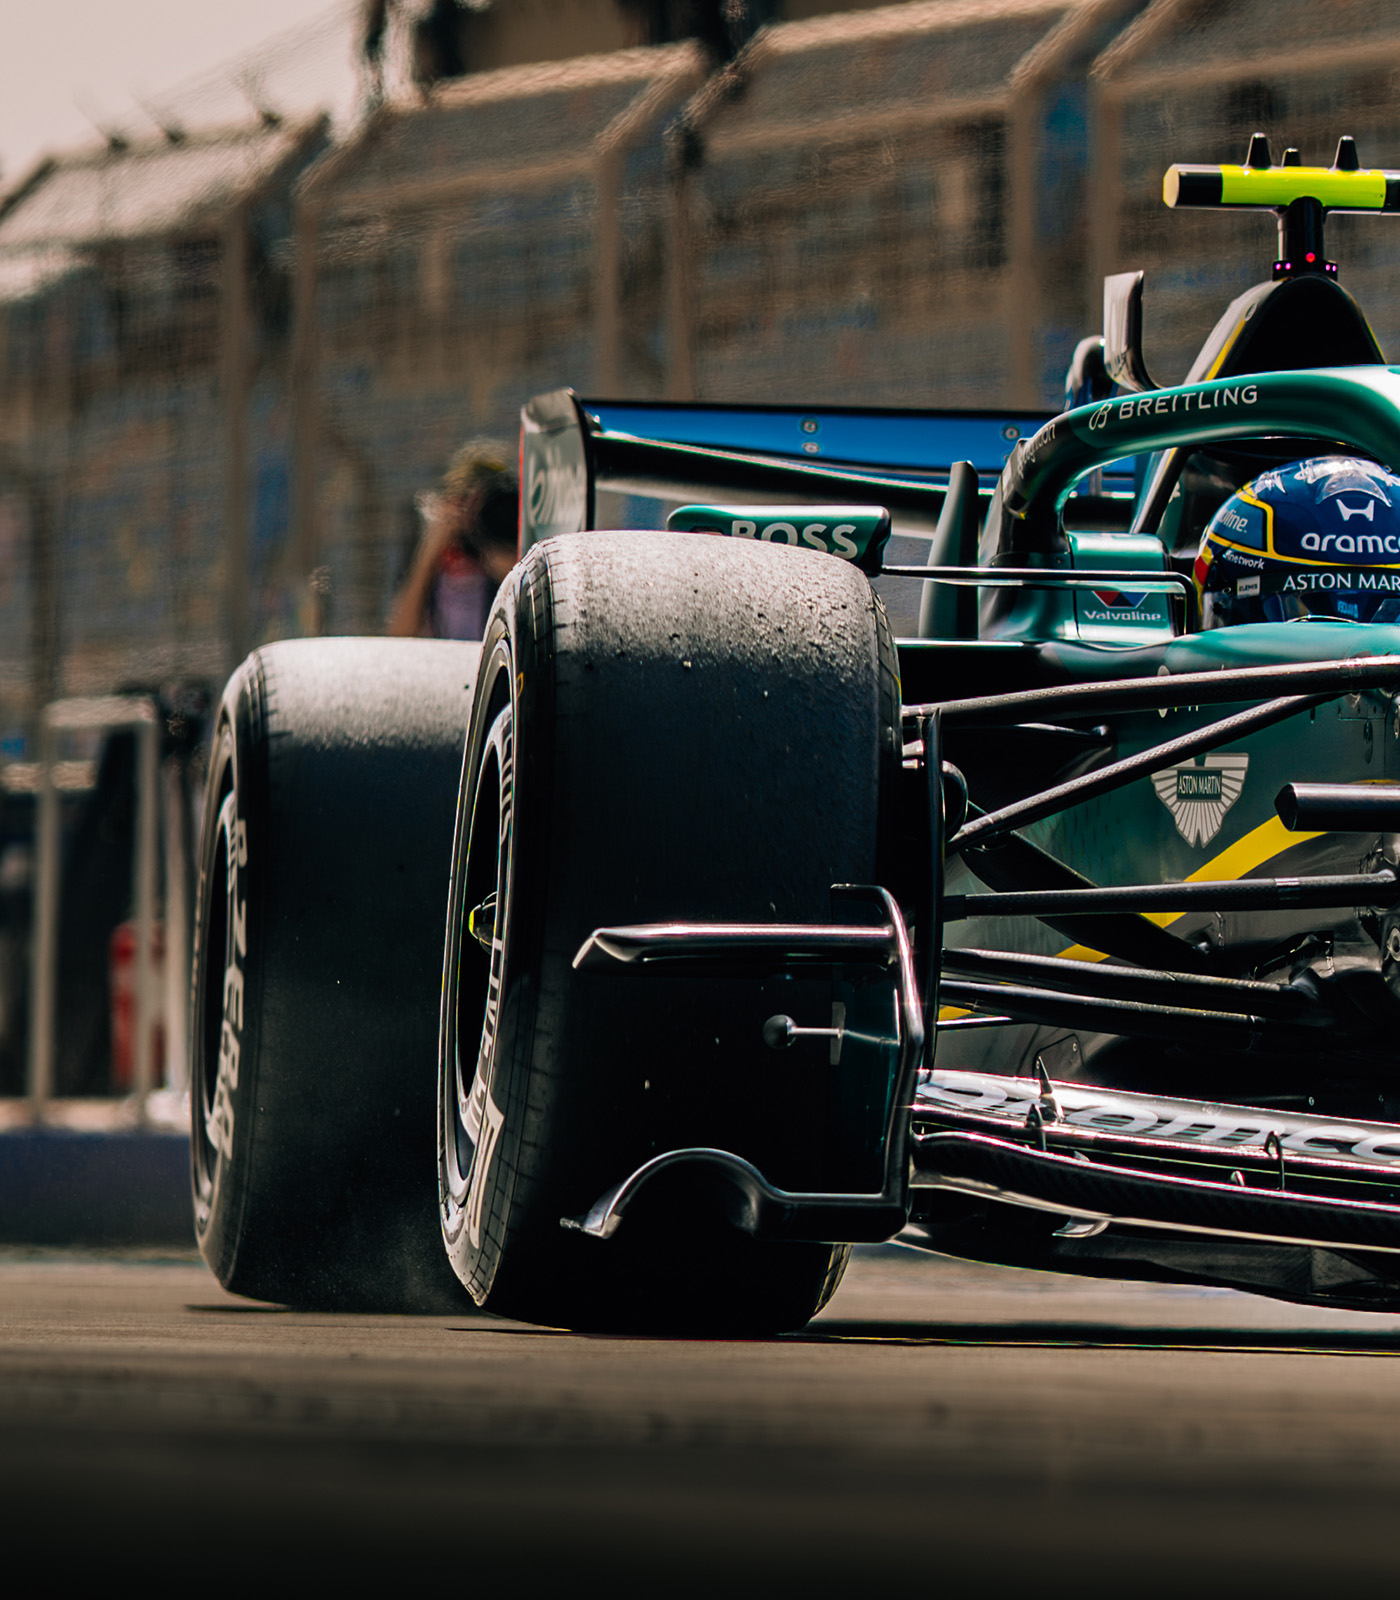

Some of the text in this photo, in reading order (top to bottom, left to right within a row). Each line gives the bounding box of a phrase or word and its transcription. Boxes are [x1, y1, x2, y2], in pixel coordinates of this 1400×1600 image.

[1119, 385, 1258, 419] BREITLING
[1283, 574, 1351, 590] ASTON
[1083, 610, 1161, 620] Valvoline
[1178, 776, 1221, 794] ASTON MARTIN
